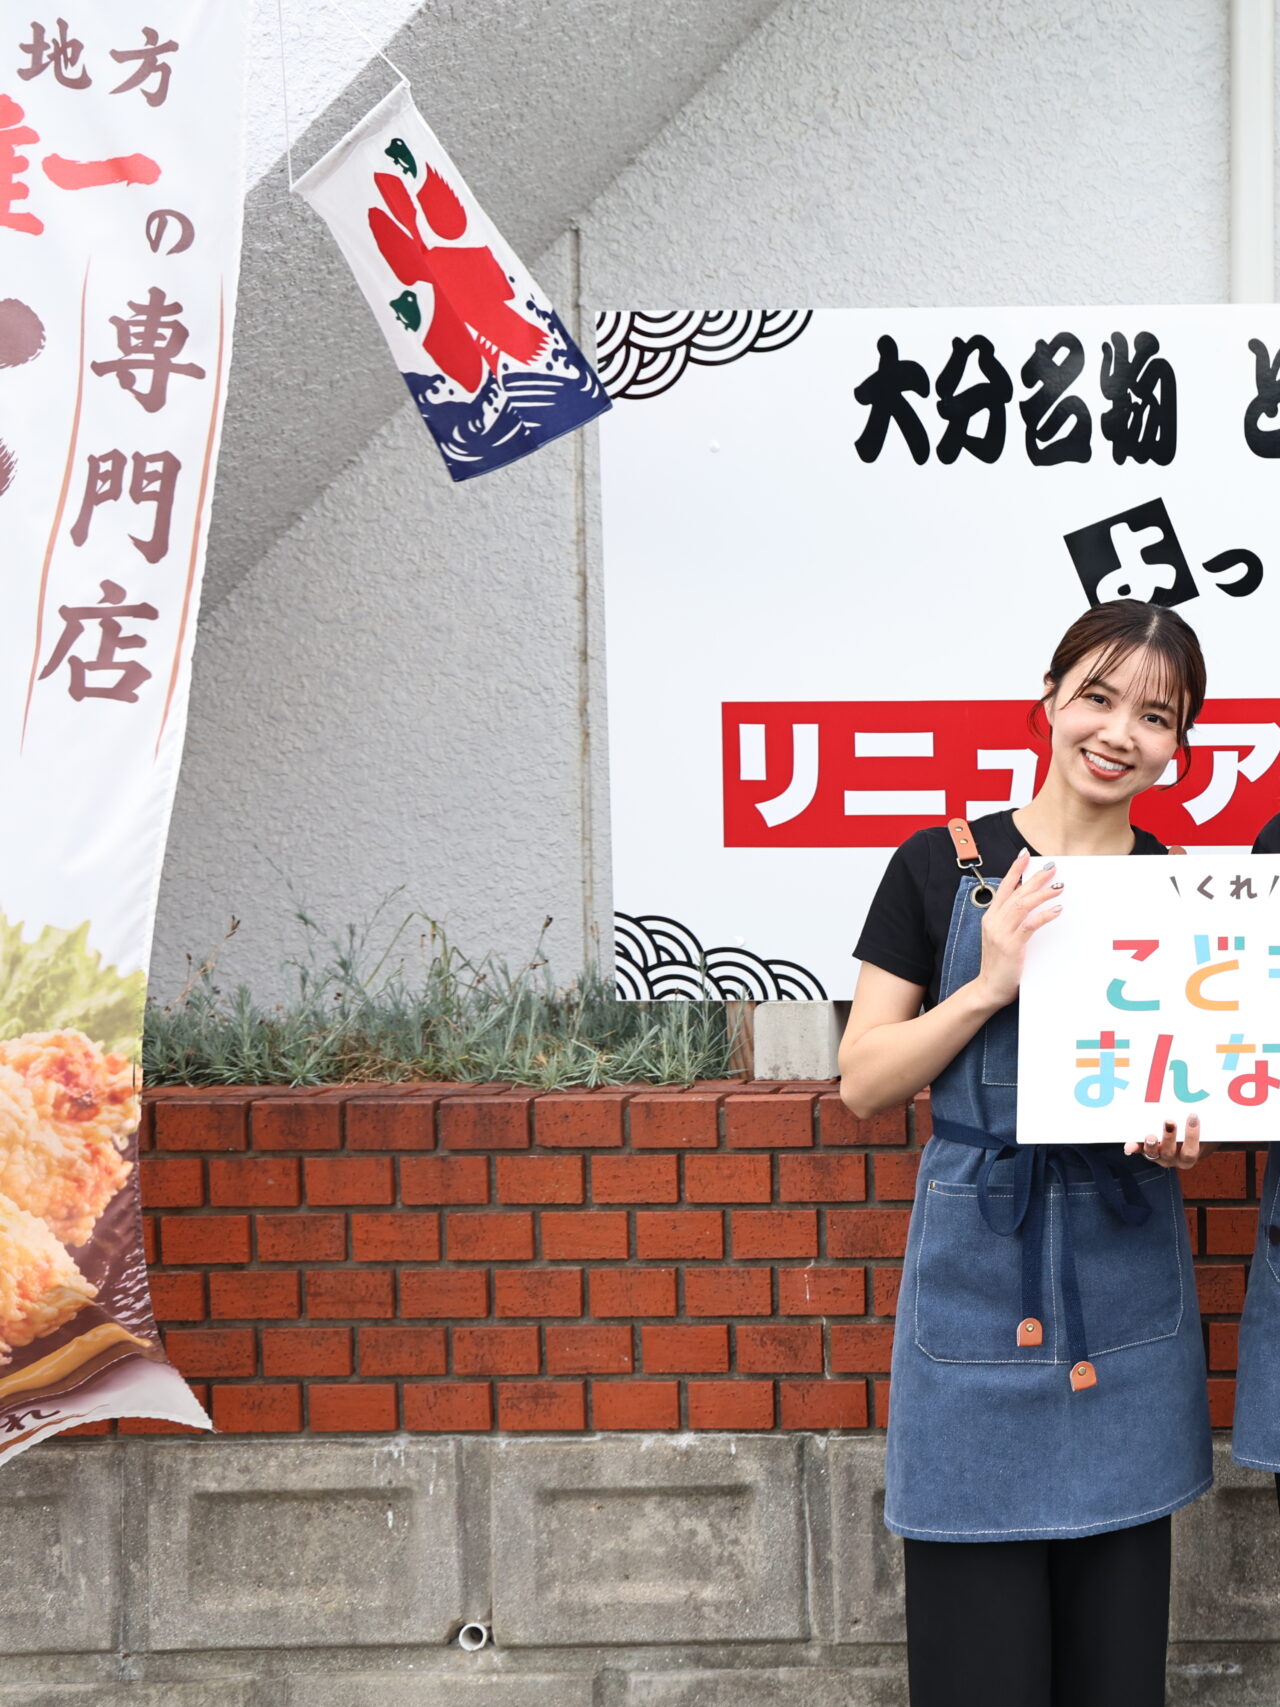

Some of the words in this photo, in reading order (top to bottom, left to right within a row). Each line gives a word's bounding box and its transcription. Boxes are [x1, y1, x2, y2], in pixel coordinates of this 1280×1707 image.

[18, 18, 179, 107] 地方
[854, 331, 1176, 466] 大分名物
[1197, 874, 1258, 900] くれ
